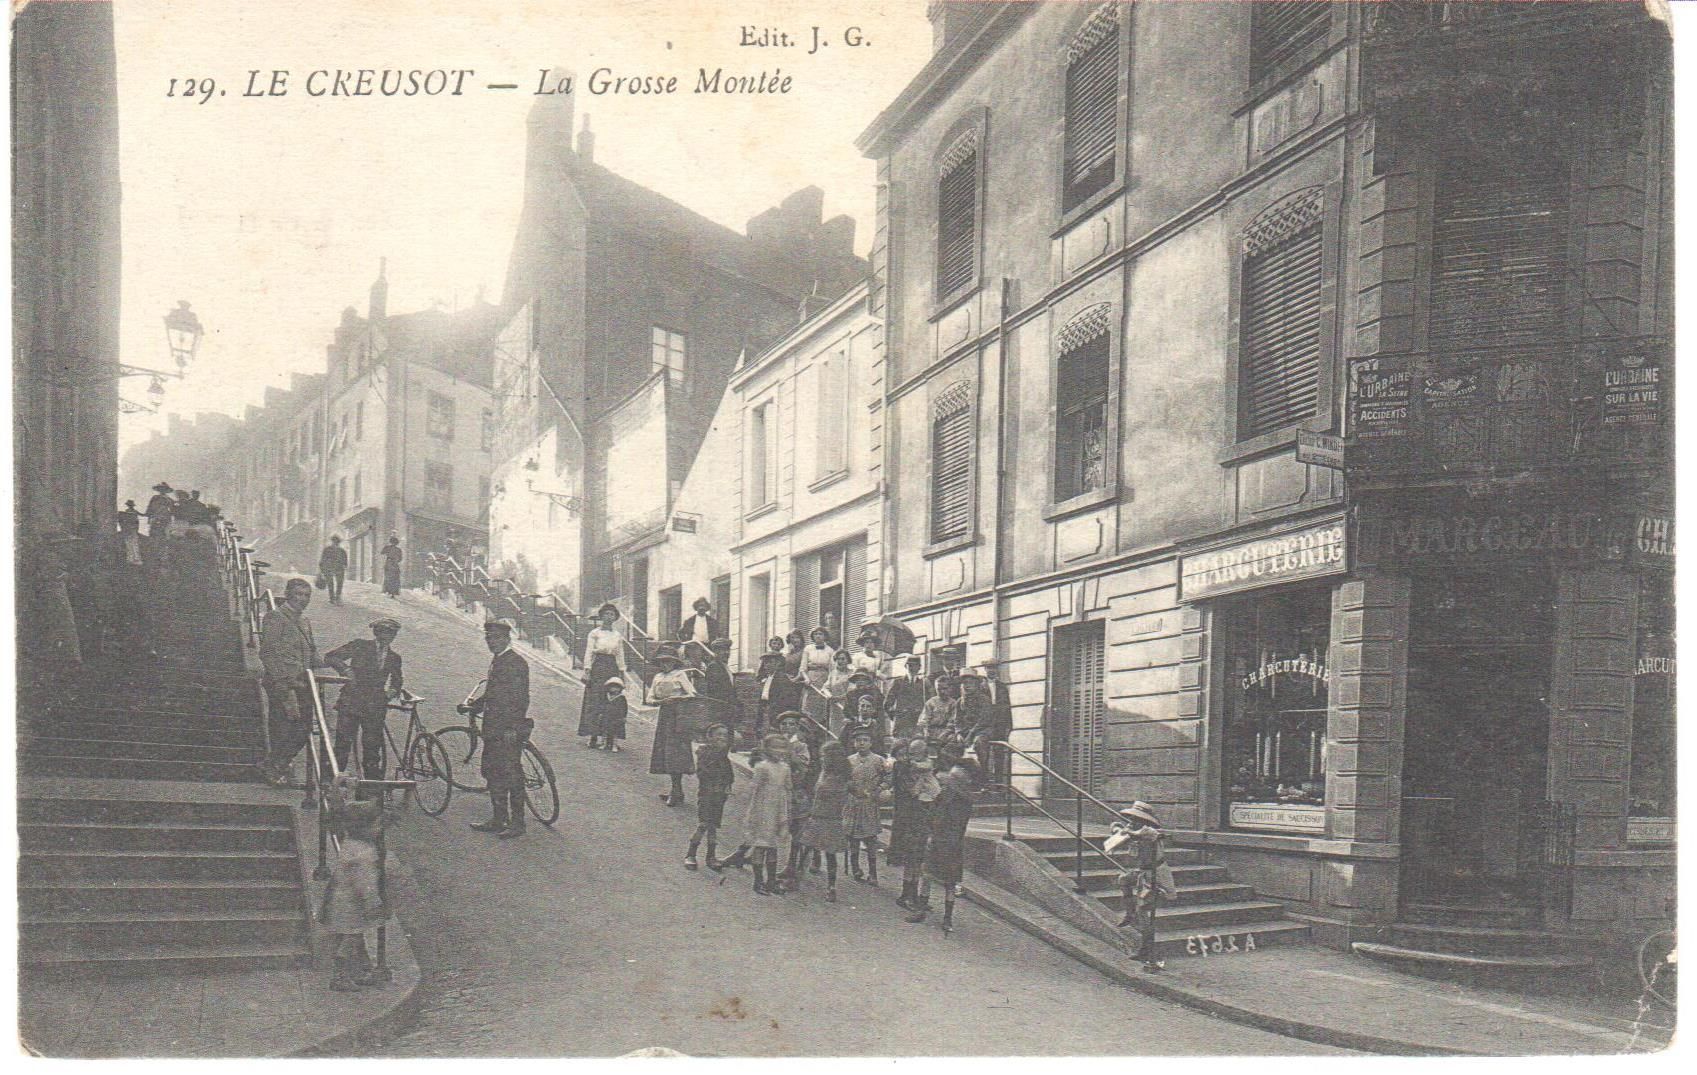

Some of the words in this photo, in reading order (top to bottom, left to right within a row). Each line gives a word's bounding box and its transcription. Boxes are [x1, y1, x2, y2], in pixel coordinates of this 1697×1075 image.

[1605, 393, 1627, 404] SUR
[1628, 391, 1640, 402] LA
[1641, 390, 1658, 402] VIE
[1360, 407, 1407, 422] ACCIDENTS
[1182, 526, 1343, 590] CHARCUTERIE
[1242, 659, 1332, 690] CHARCUTERIE
